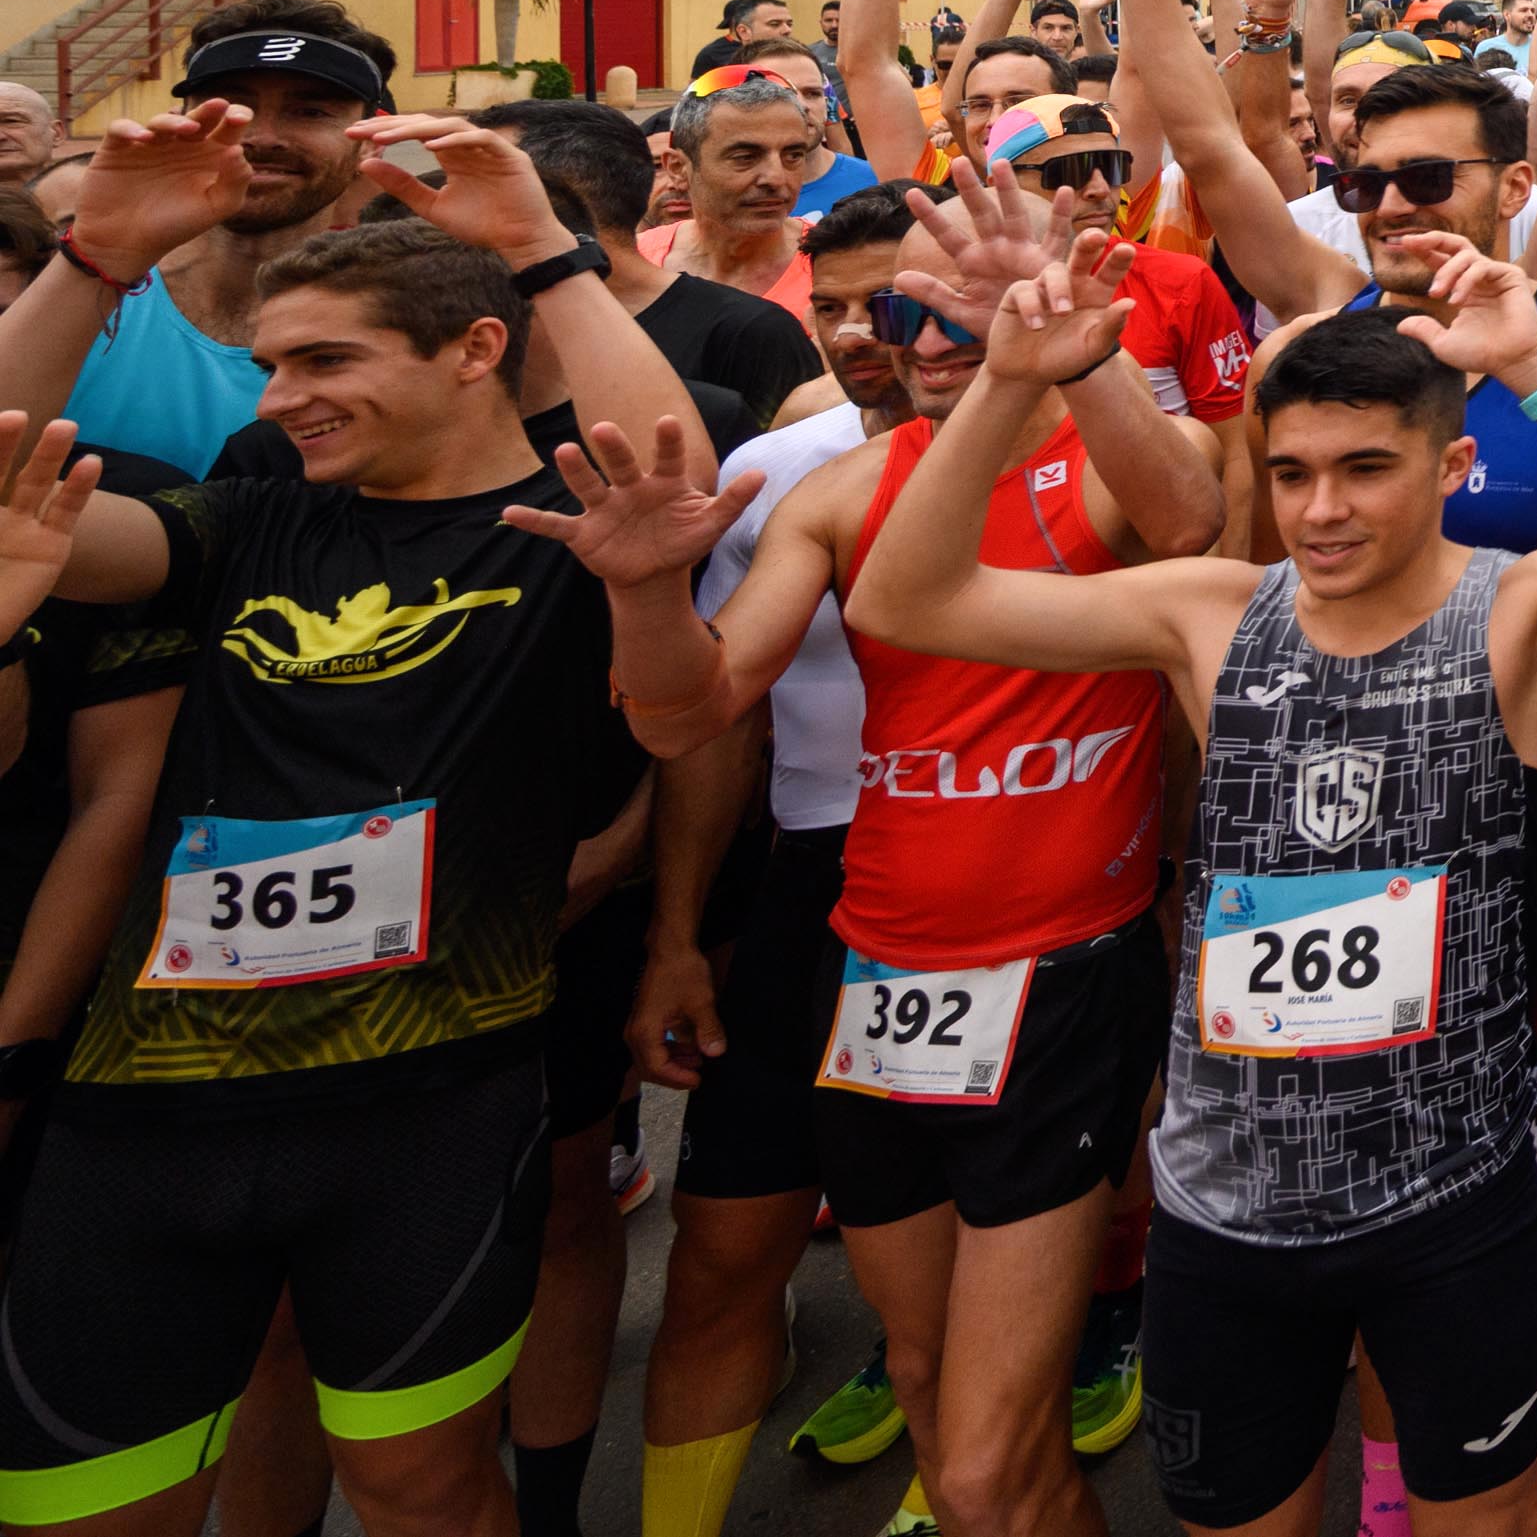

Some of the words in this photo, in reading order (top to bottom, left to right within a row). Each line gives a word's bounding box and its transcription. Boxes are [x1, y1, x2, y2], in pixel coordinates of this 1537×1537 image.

[210, 863, 357, 931] 365
[1248, 925, 1381, 993] 268
[865, 984, 973, 1046] 392
